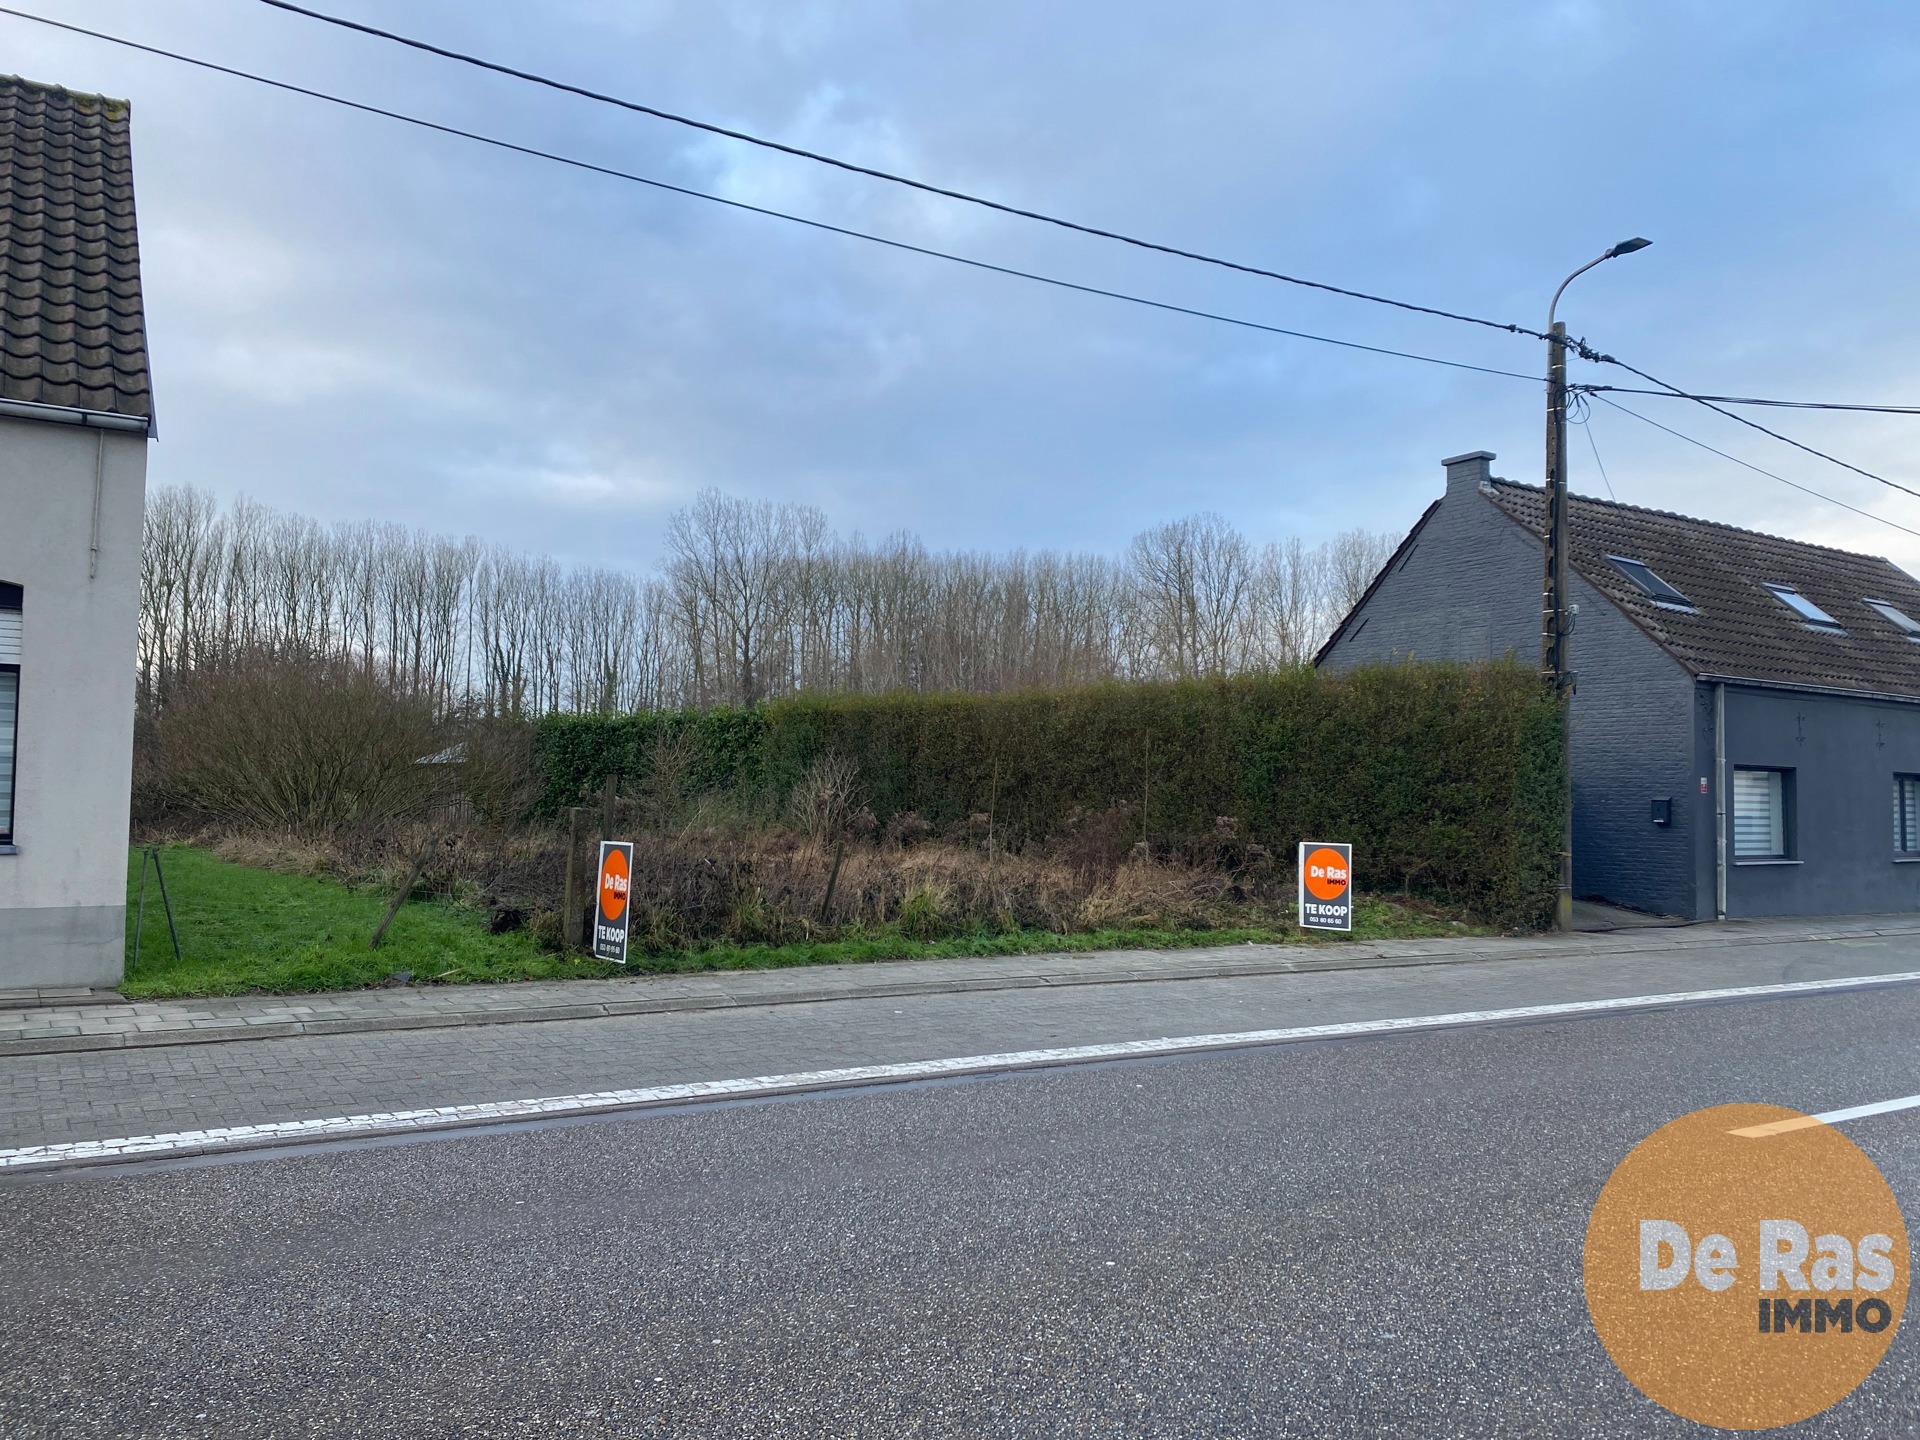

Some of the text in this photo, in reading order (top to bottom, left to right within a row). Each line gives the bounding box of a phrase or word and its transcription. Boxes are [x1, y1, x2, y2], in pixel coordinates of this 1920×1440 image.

[1311, 865, 1347, 879] De Ras
[605, 873, 627, 891] De Ras
[614, 892, 626, 900] IMMO
[1305, 903, 1348, 917] TE KOOP
[598, 925, 625, 943] TE KOOP
